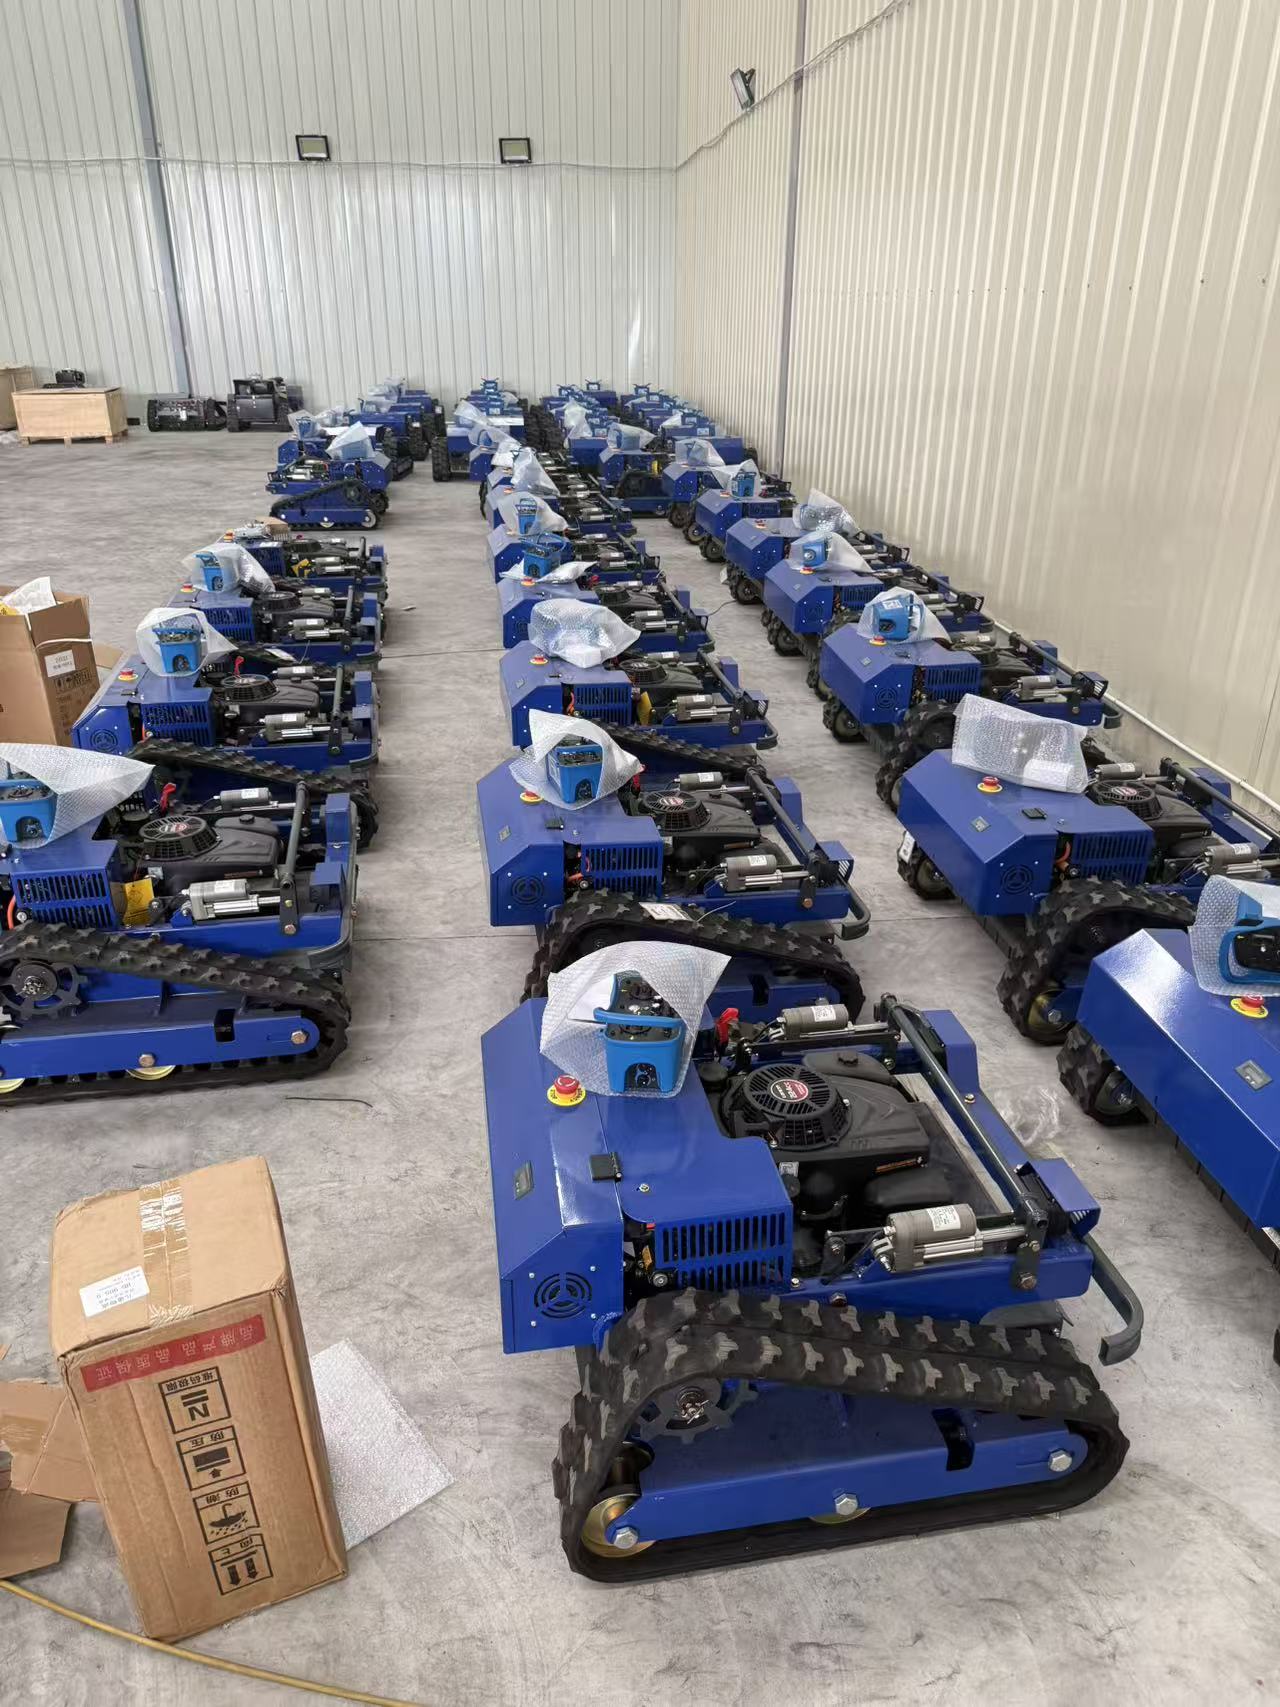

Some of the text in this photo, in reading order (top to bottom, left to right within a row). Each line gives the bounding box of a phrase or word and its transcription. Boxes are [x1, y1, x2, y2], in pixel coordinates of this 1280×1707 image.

[95, 1324, 253, 1381] 品牌产品 品质保证
[166, 1371, 214, 1392] 堆码极限
[190, 1430, 225, 1448] 防压
[206, 1486, 240, 1504] 防潮
